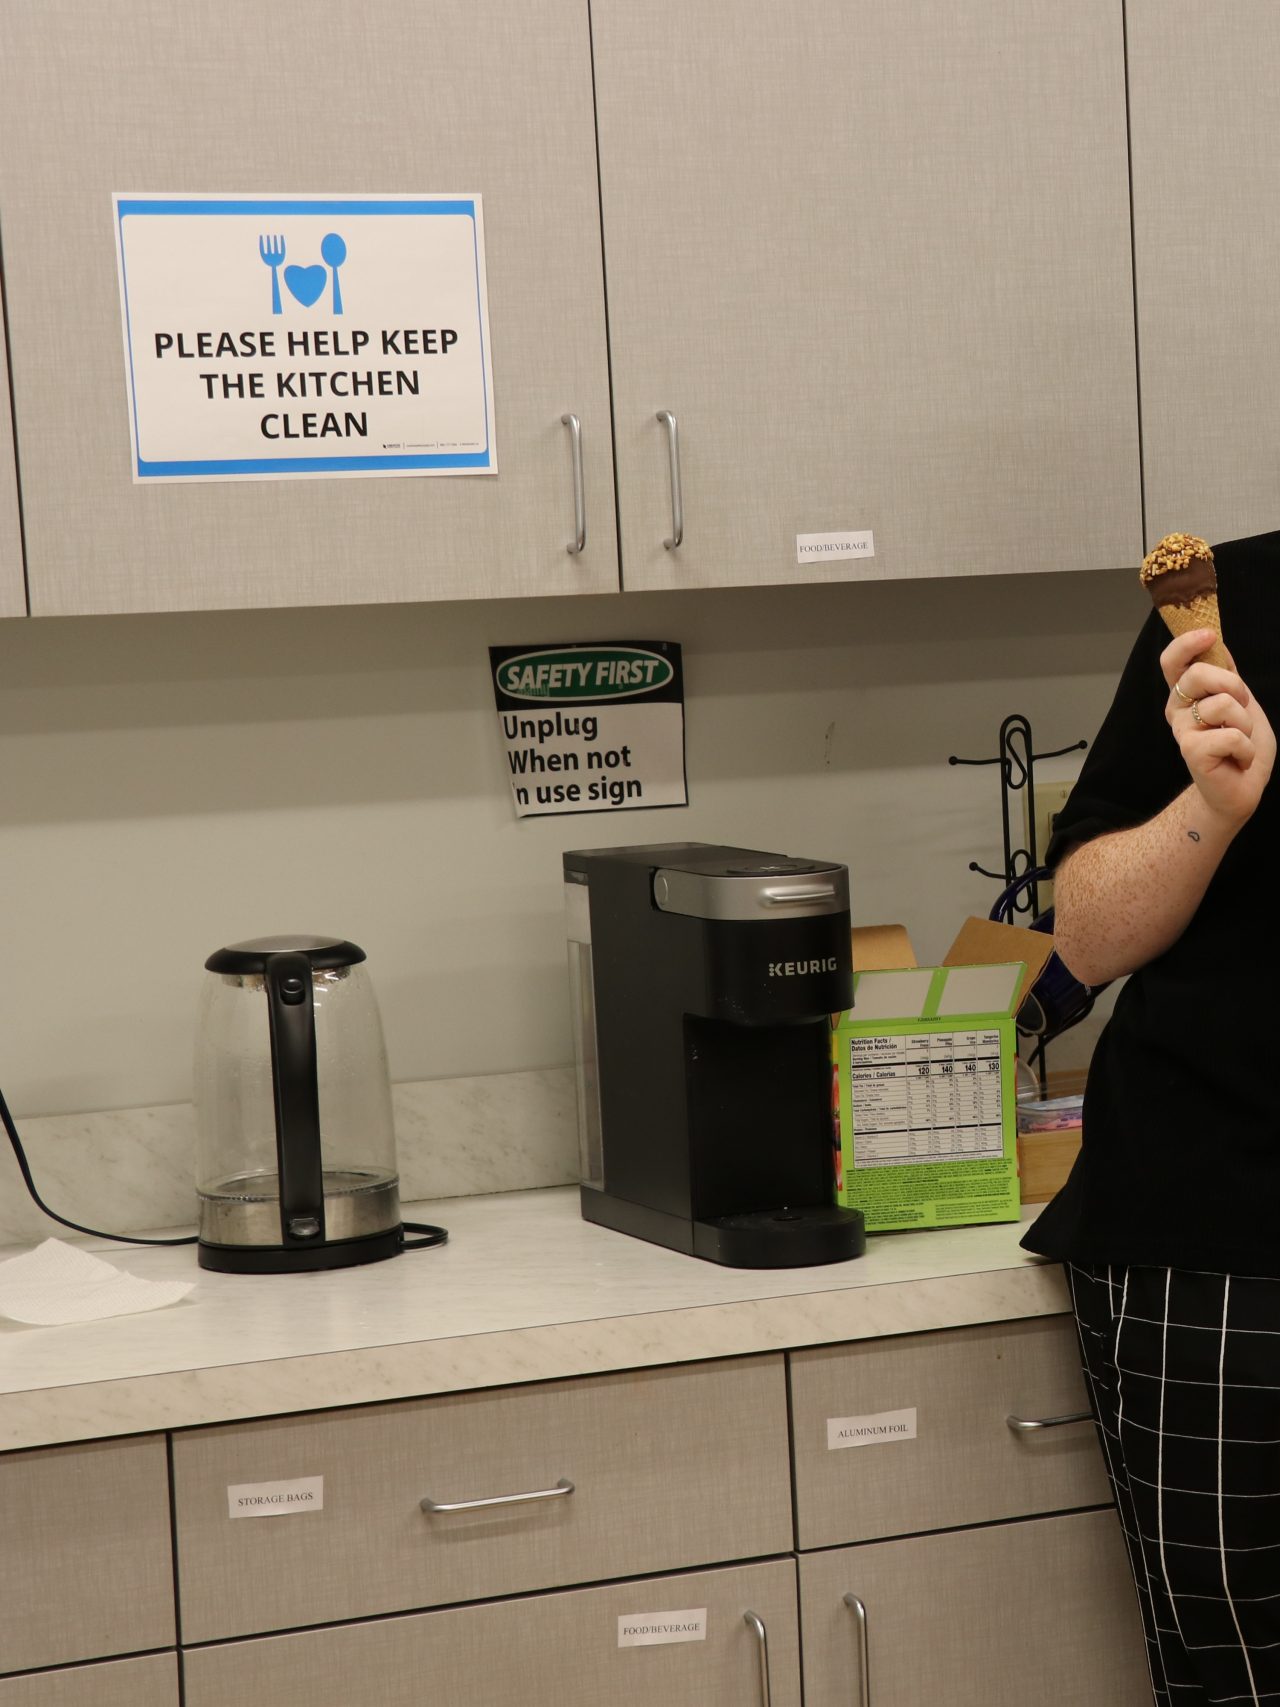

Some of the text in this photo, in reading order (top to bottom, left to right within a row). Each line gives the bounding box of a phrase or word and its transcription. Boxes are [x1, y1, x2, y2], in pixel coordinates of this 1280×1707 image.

[154, 329, 458, 358] PLEASE HELP KEEP
[200, 370, 420, 399] THE KITCHEN
[260, 412, 368, 439] CLEAN
[800, 542, 868, 552] FOOD/BEVERAGE
[507, 660, 659, 690] SAFETY FIRST
[504, 712, 598, 743] Unplug
[508, 746, 631, 774] When not
[513, 775, 642, 805] n use sign
[768, 957, 837, 976] KEURIG
[918, 1066, 930, 1075] 120
[941, 1065, 953, 1073] 140
[965, 1064, 976, 1072] 140
[988, 1062, 1000, 1070] 130
[838, 1424, 909, 1438] ALUMINUM FOIL
[238, 1492, 313, 1506] STORAGE BAGS
[623, 1623, 700, 1635] FOOD/BEVERAGE
